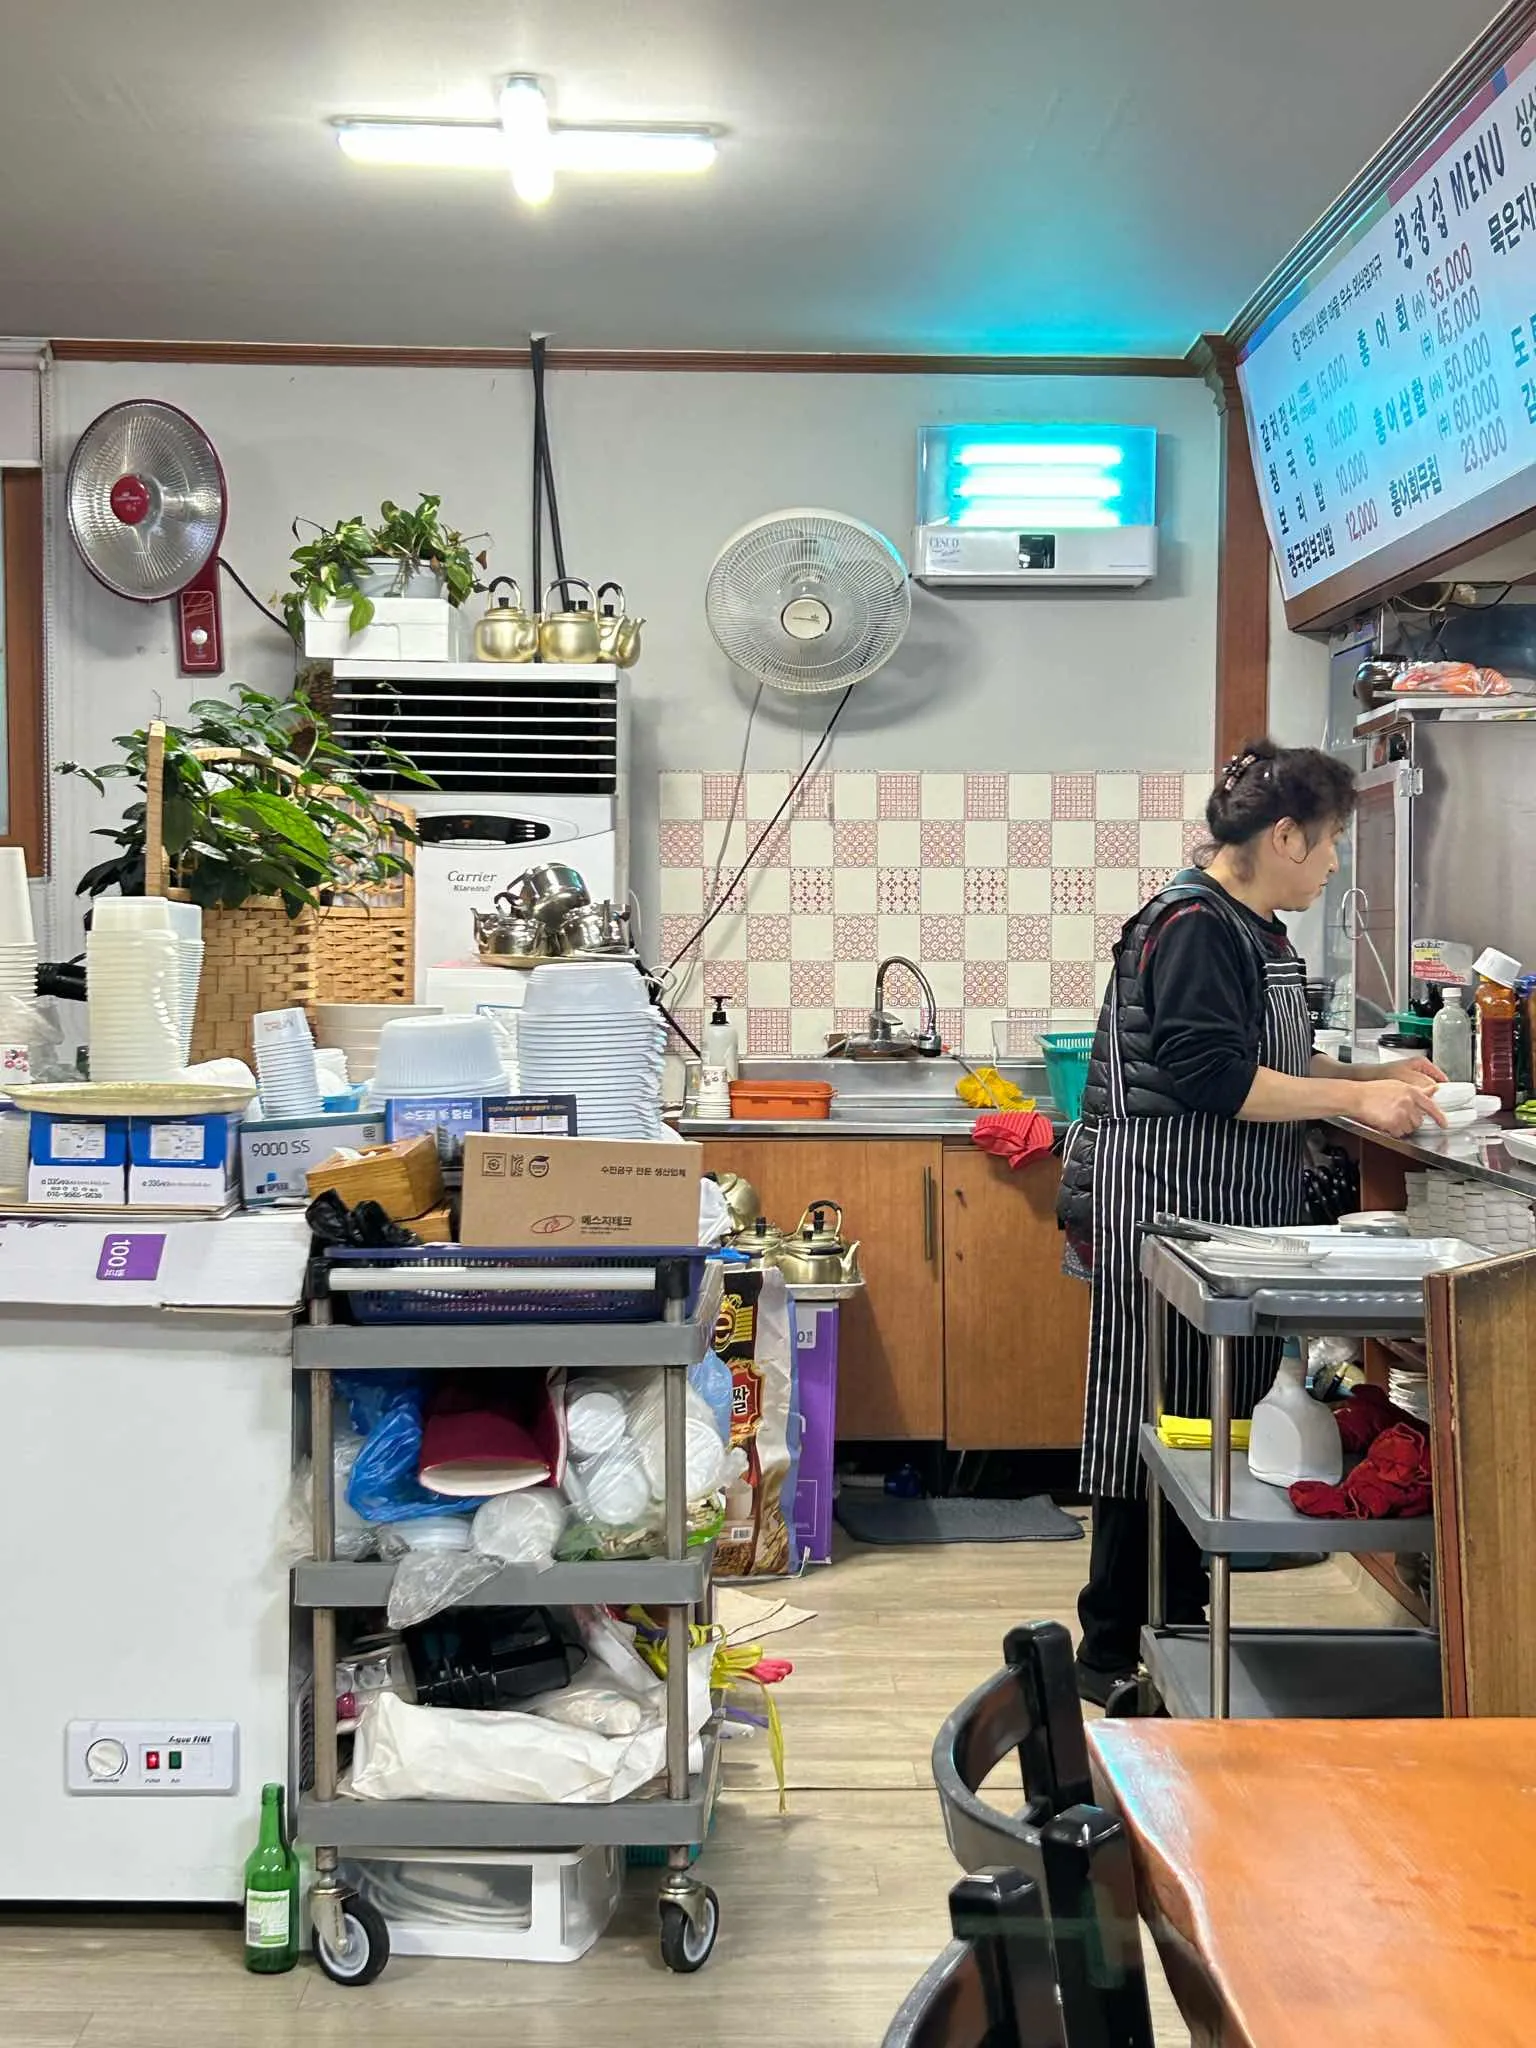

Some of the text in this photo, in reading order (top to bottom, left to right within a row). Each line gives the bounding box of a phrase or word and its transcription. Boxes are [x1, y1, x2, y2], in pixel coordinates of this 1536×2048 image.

[1394, 176, 1449, 270] 친정집
[1449, 122, 1505, 216] MENU
[1488, 182, 1536, 256] 묵은지
[1426, 242, 1472, 308] 35,000
[1436, 285, 1480, 347] 45,000
[1444, 331, 1491, 393] 50,000
[1453, 373, 1499, 433] 60,000
[1336, 450, 1369, 496] 10,000
[1389, 415, 1508, 517] 홍어회무침 23,000
[1287, 498, 1378, 578] 청국장보리밥 12,000
[448, 871, 497, 882] Carrier
[252, 1140, 311, 1157] 9000 SS
[108, 1239, 132, 1267] 100
